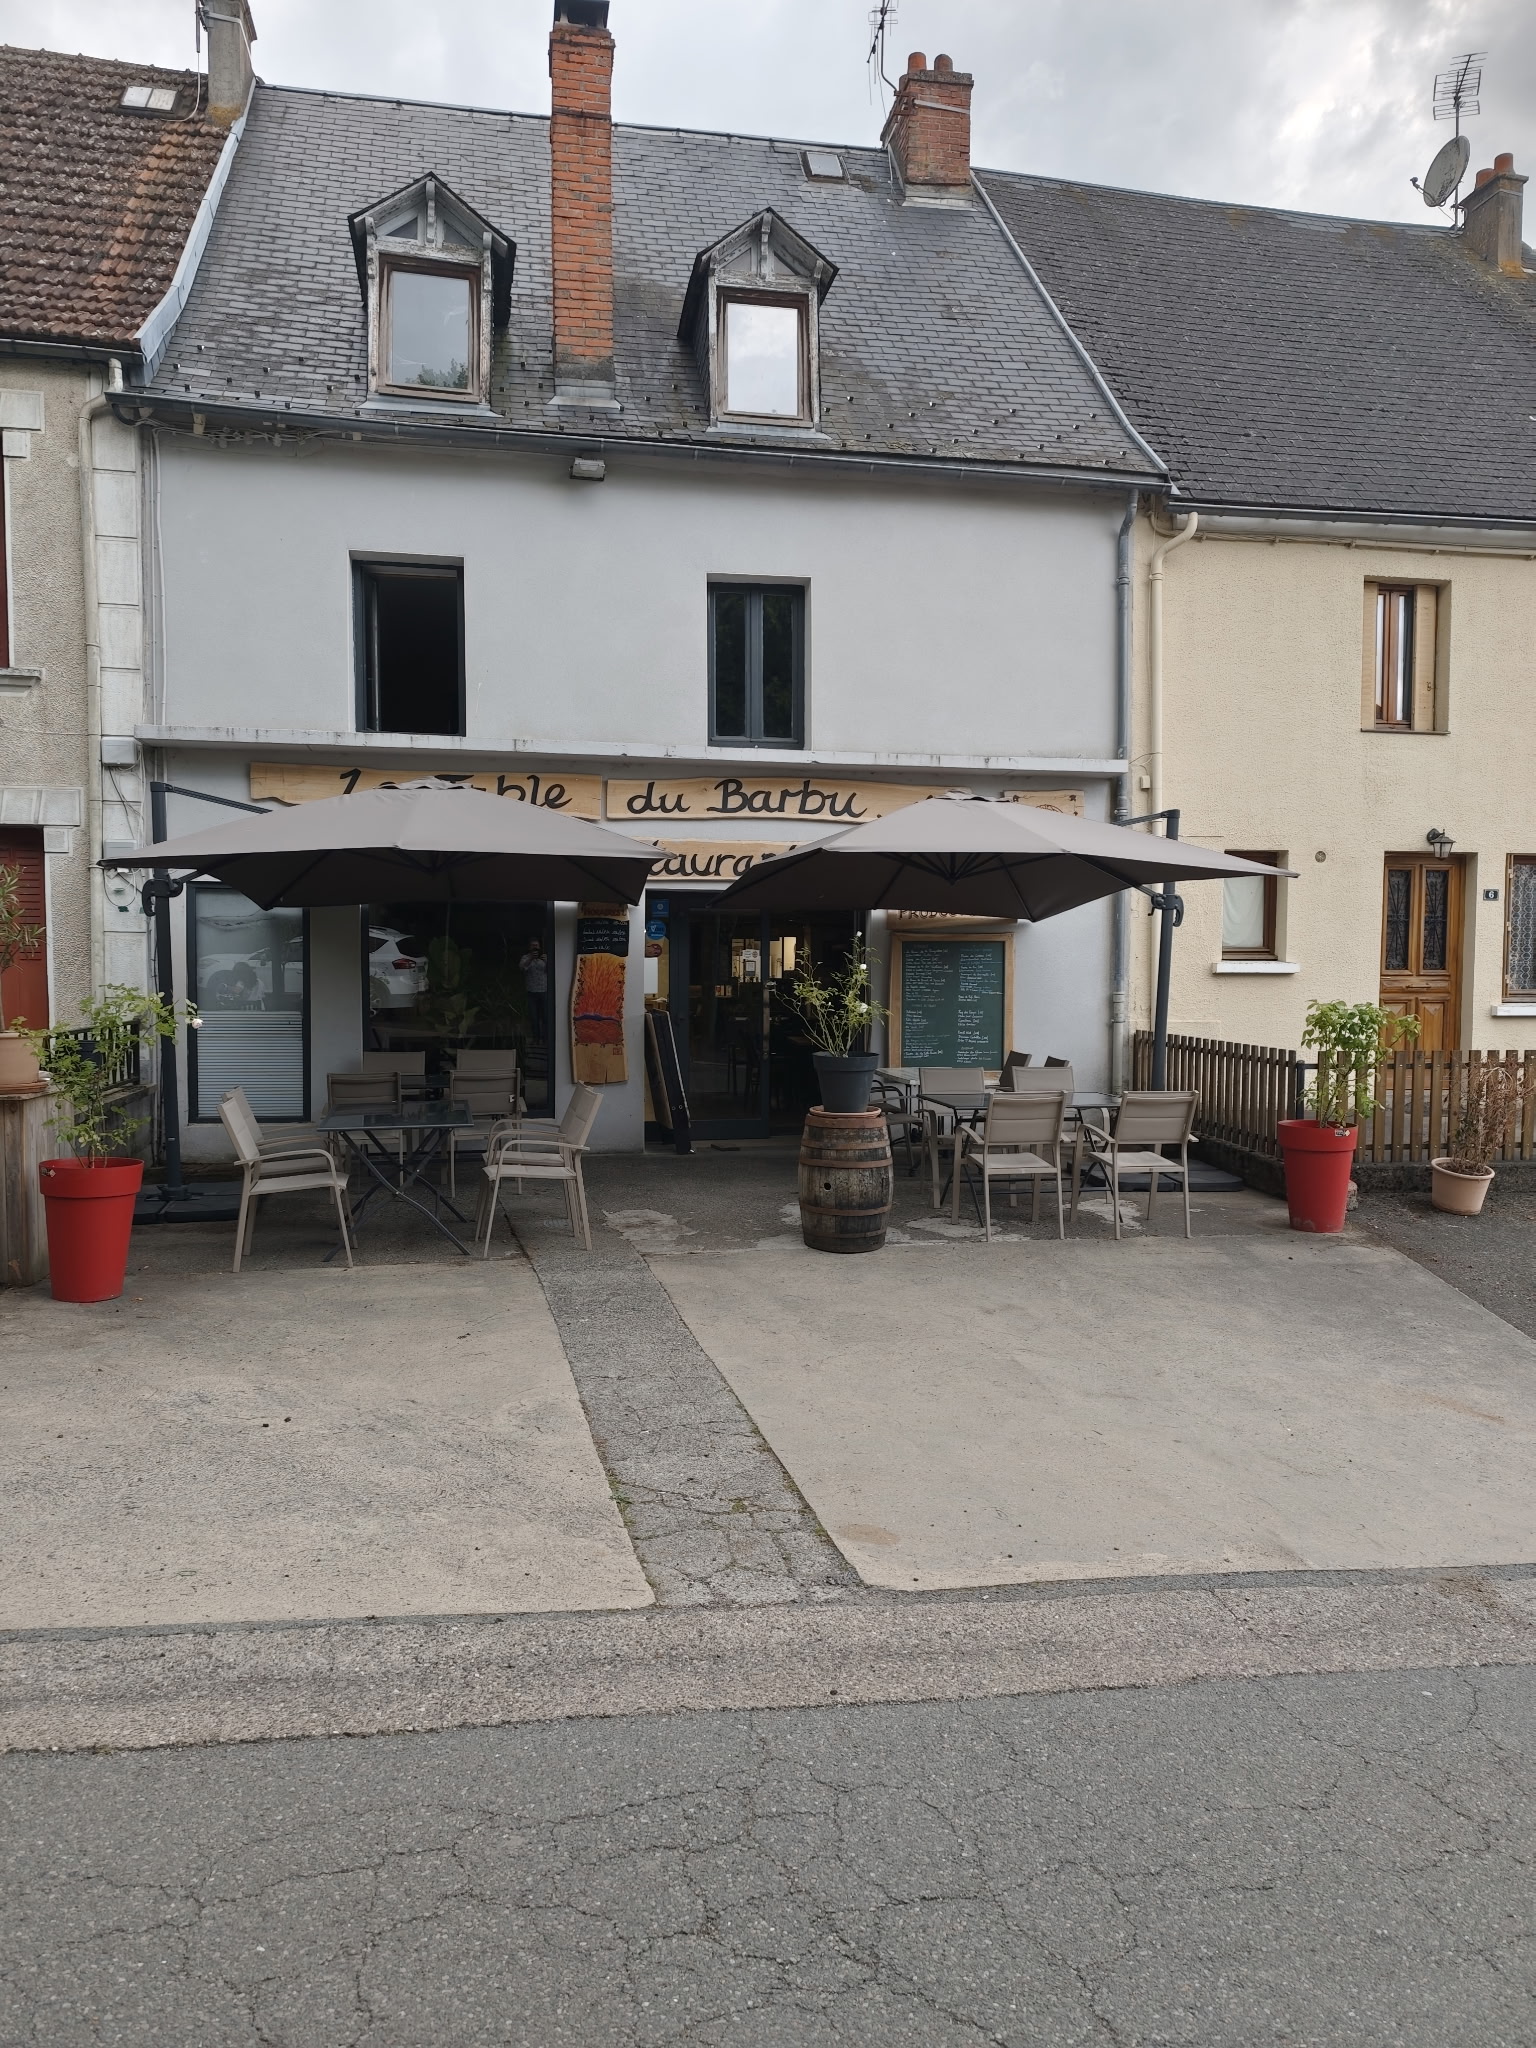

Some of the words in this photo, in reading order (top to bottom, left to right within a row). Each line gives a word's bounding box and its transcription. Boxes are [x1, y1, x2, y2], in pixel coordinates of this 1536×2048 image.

[435, 774, 573, 809] ble
[626, 781, 691, 815] du
[706, 778, 868, 818] Barbu
